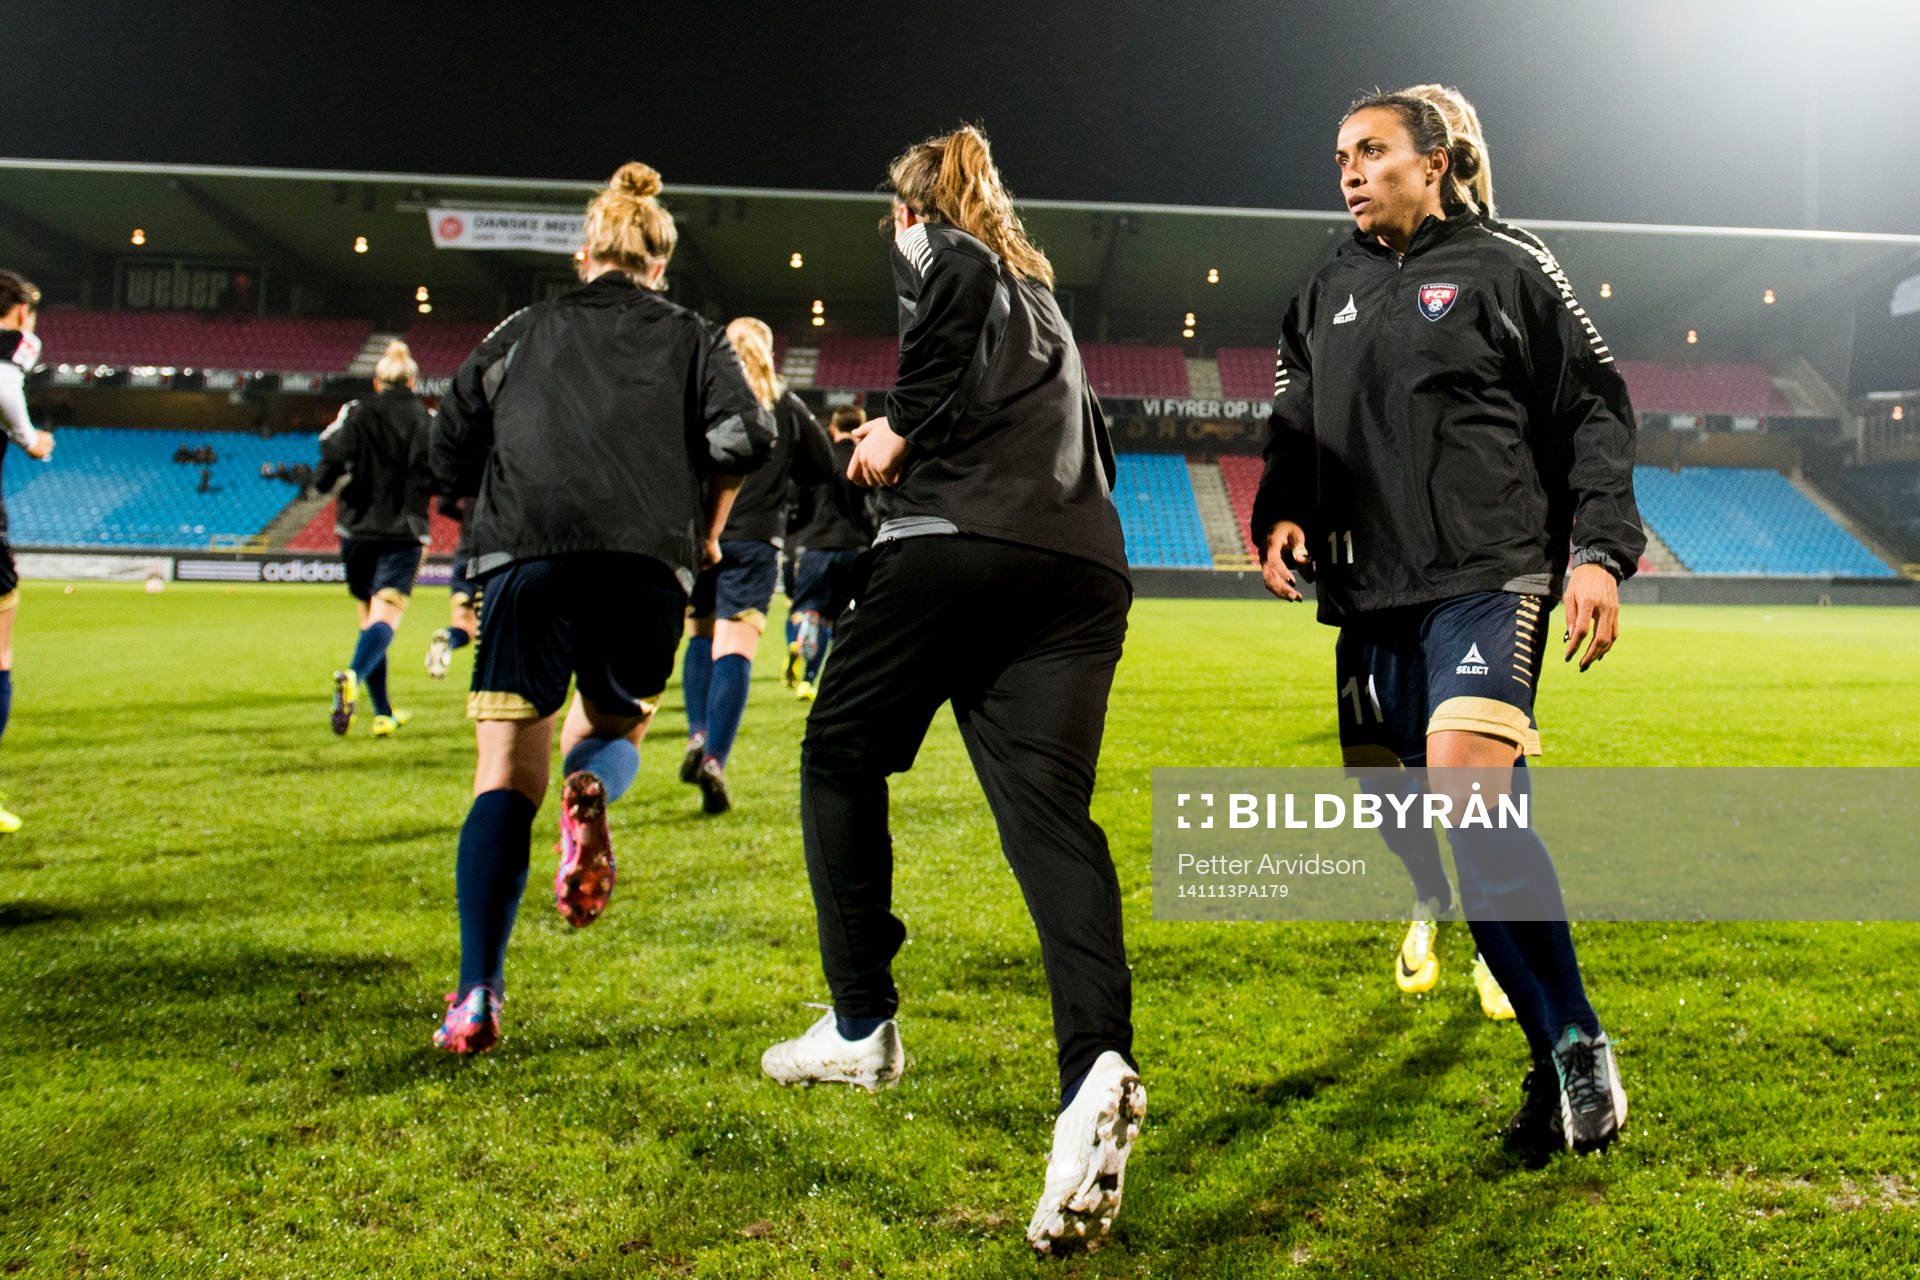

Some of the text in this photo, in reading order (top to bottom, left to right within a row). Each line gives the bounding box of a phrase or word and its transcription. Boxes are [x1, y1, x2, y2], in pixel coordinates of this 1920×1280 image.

[128, 262, 228, 309] weber
[1425, 290, 1451, 299] FCR
[1143, 399, 1160, 417] VI
[1164, 400, 1220, 418] FYRER
[1223, 401, 1249, 419] OP
[1328, 530, 1354, 565] 11
[1456, 665, 1489, 675] SELECT
[1341, 674, 1384, 725] 11
